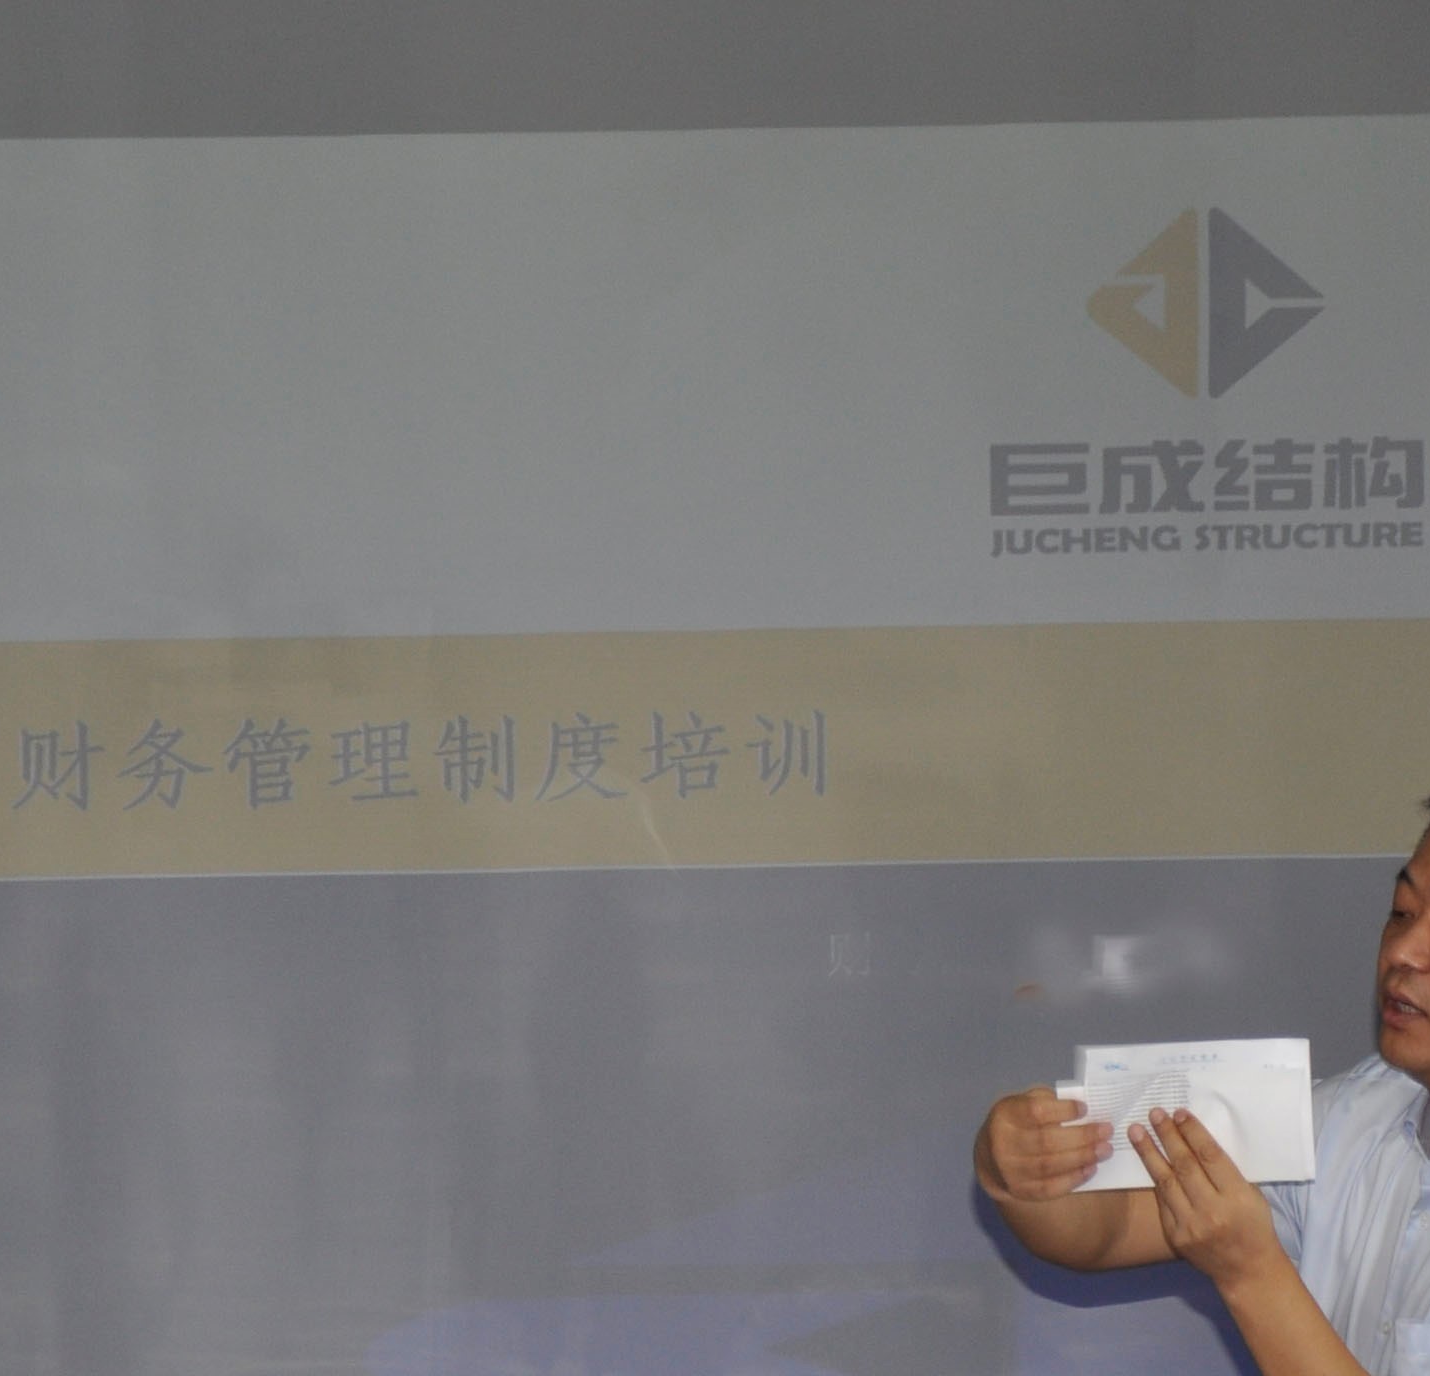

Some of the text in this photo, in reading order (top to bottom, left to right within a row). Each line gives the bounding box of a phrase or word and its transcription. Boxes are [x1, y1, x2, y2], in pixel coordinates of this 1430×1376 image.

[989, 435, 1425, 517] 巨成结构
[990, 521, 1424, 557] JUCHENG STRUCTURE
[12, 708, 831, 812] 财务管理制度培训
